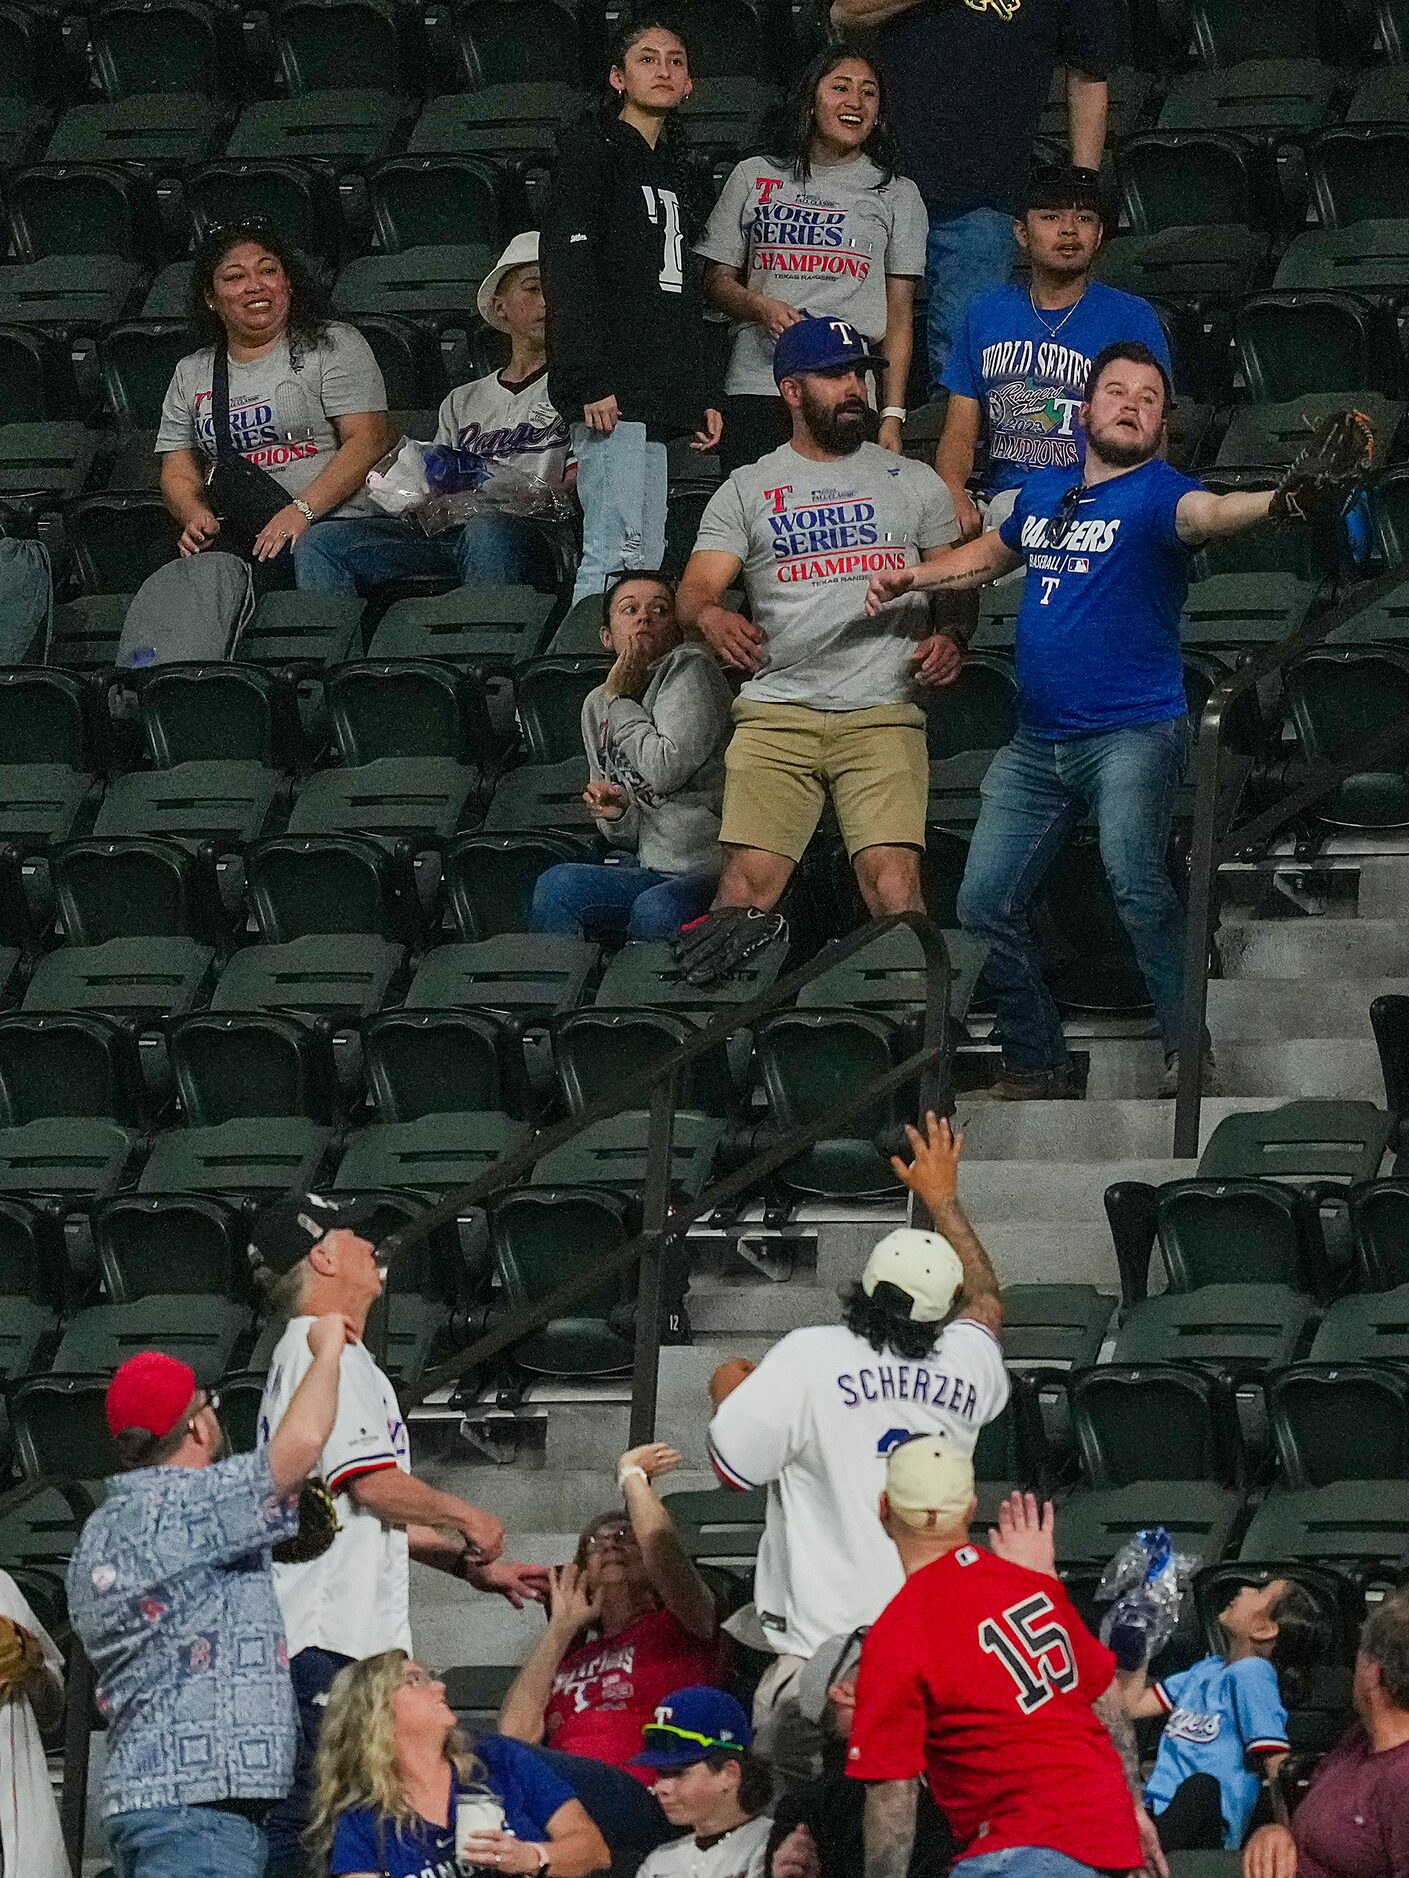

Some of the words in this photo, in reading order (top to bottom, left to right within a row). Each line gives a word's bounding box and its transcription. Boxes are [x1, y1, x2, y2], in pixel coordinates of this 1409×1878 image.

[756, 177, 783, 205] T
[754, 204, 846, 225] WORLD
[753, 222, 844, 247] SERIES
[753, 252, 870, 280] CHAMPIONS
[829, 321, 852, 345] T
[982, 340, 1033, 379] WORLD
[1037, 341, 1092, 389] SERIES
[999, 380, 1065, 406] Rangers
[1053, 398, 1083, 436] T
[763, 485, 793, 514] T
[768, 503, 875, 536] WORLD
[772, 523, 878, 559] SERIES
[777, 552, 906, 583] CHAMPIONS
[1029, 554, 1061, 571] BASEBALL
[1040, 576, 1060, 605] T
[669, 1314, 679, 1331] 12
[838, 1366, 977, 1422] SCHERZER
[978, 1591, 1079, 1716] 15
